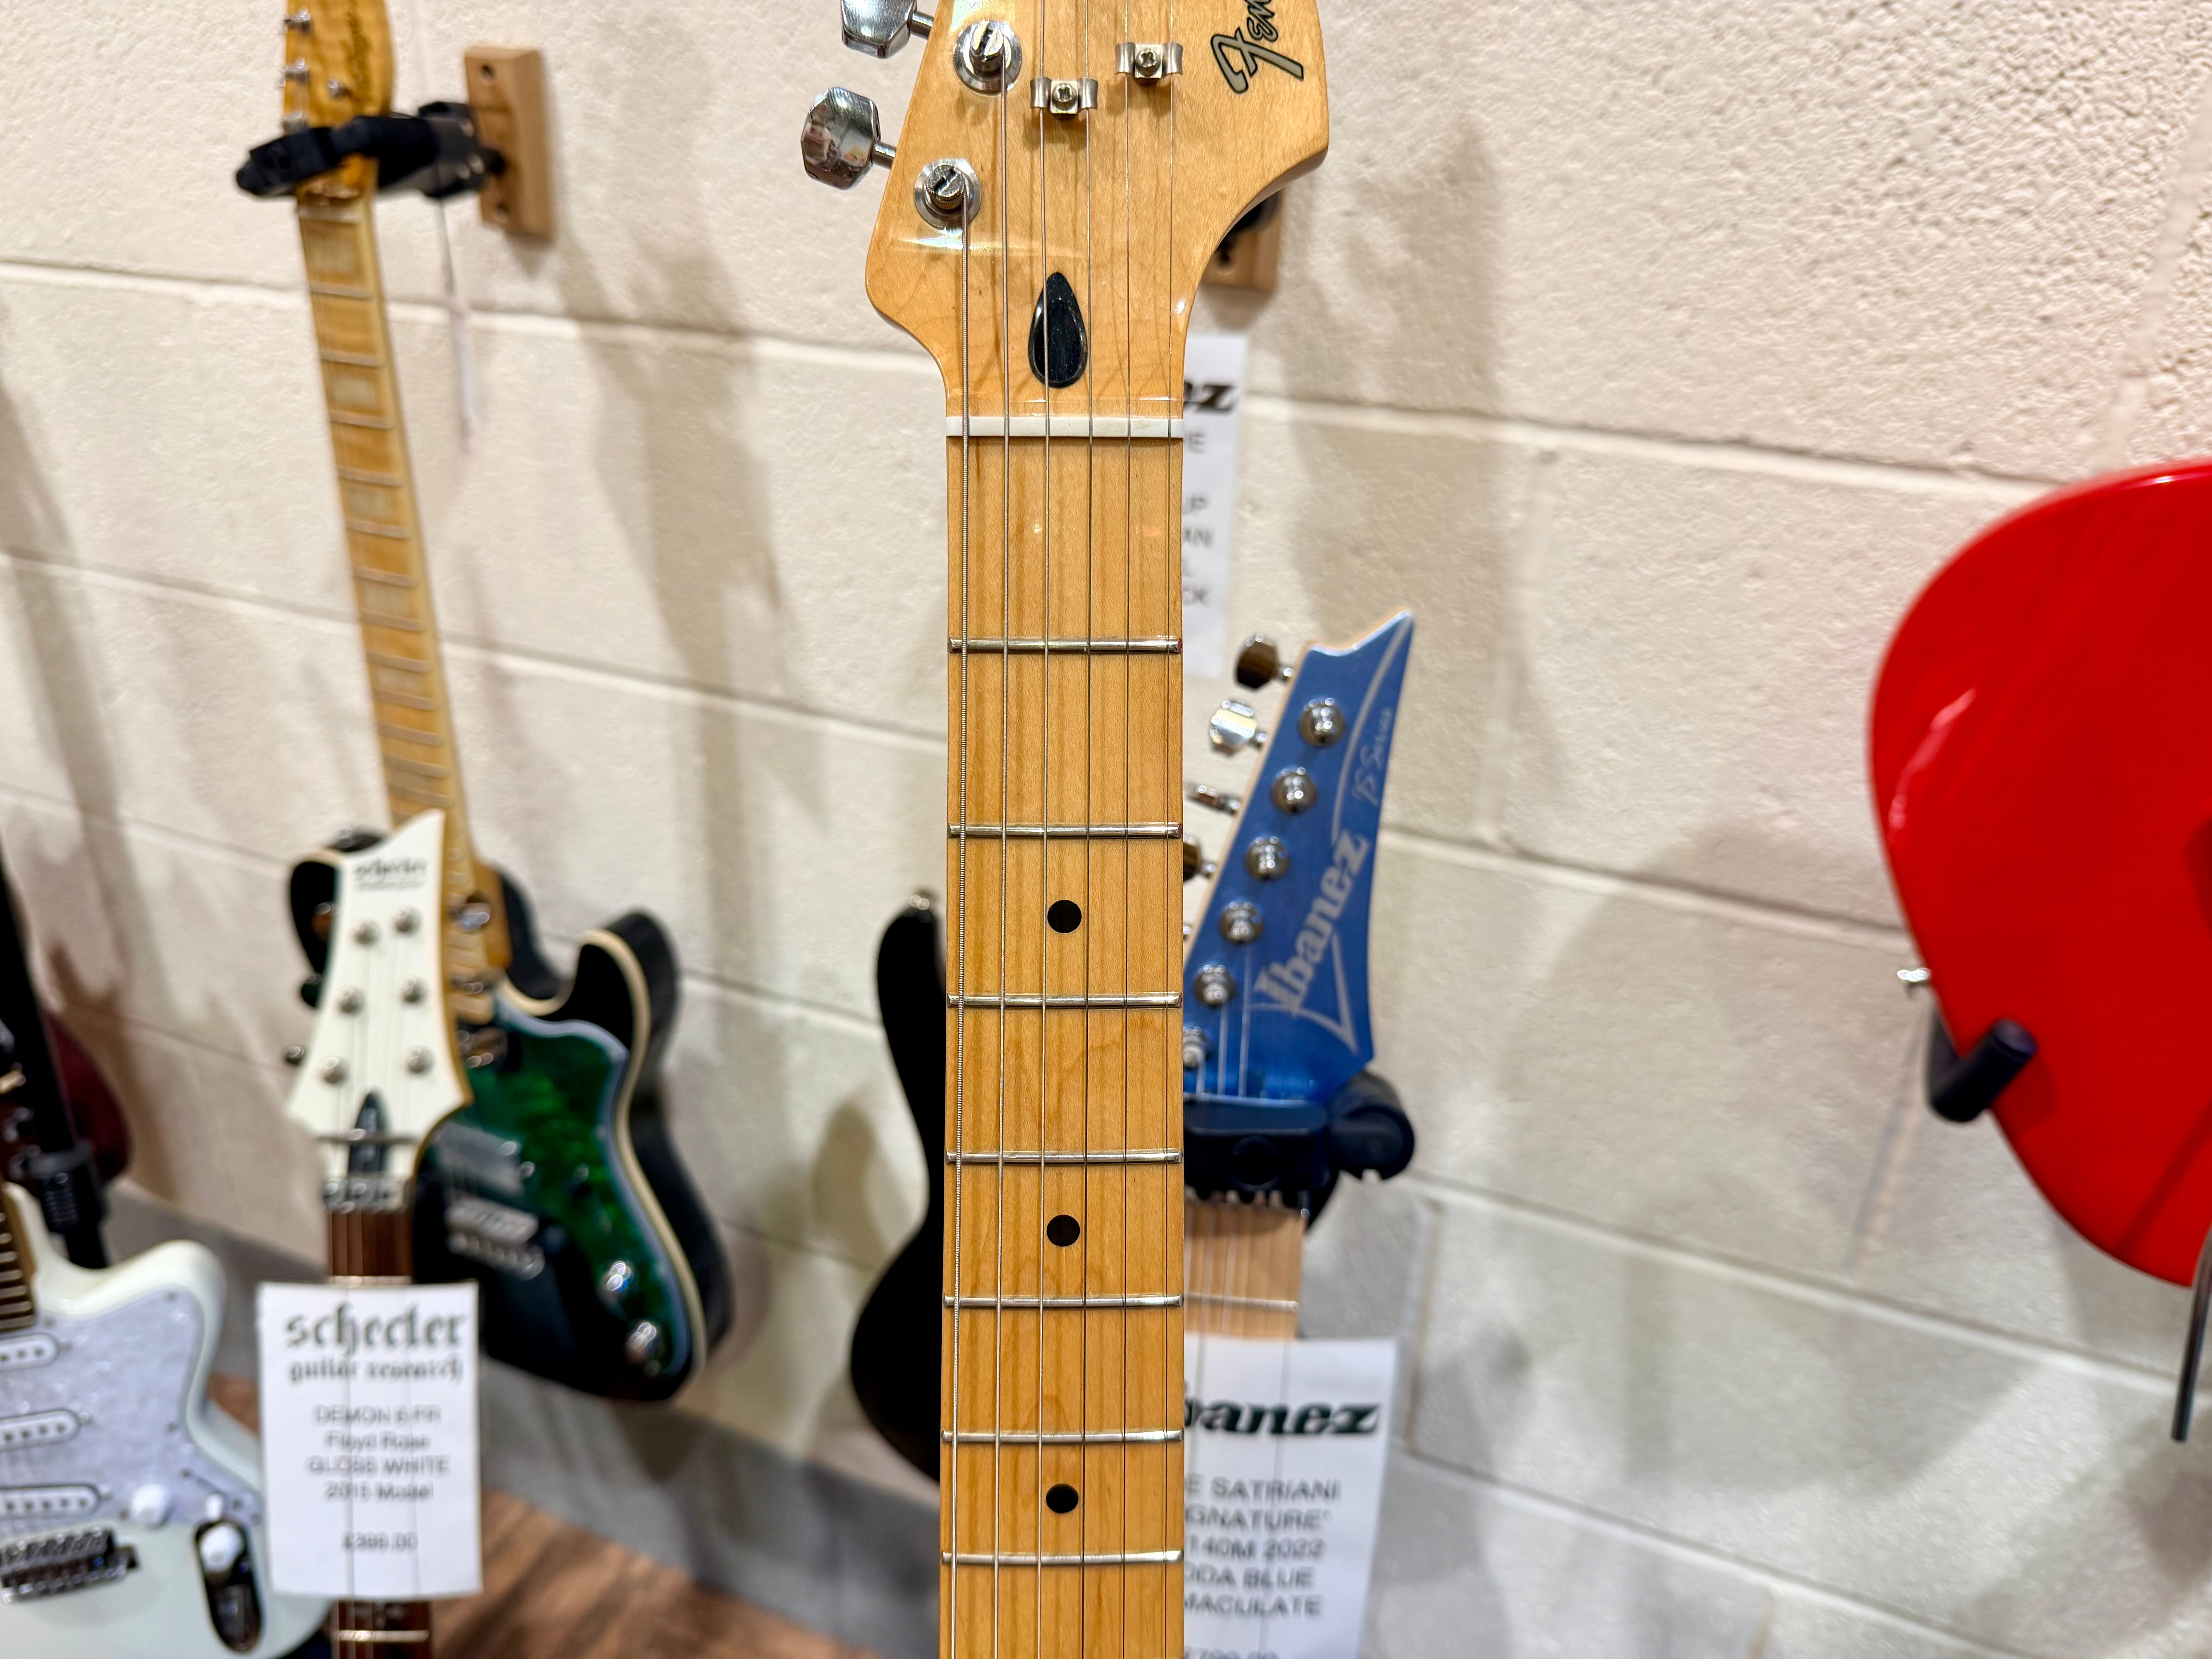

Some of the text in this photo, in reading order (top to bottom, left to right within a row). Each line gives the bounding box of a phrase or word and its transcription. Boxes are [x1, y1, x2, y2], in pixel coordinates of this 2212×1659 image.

[1252, 829, 1370, 1017] Ibanez
[286, 1300, 468, 1356] schecter
[290, 1358, 359, 1385] guitar
[314, 1405, 391, 1425] DEMON
[325, 1430, 377, 1452] Floyd
[306, 1455, 450, 1476] GLOSS WHITE
[374, 1480, 433, 1501] Model
[1211, 1476, 1341, 1503] SATRIANI
[1264, 1537, 1326, 1562] 2022
[1243, 1566, 1315, 1590] BLUE
